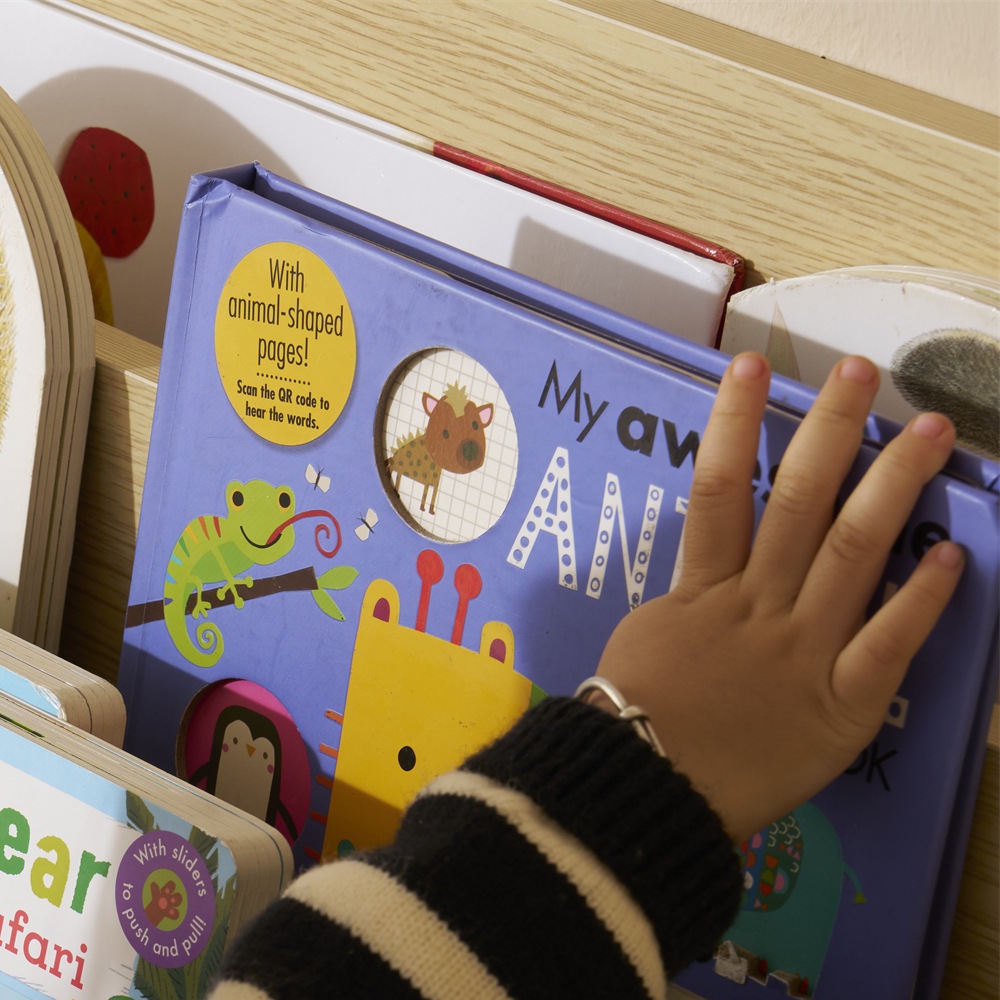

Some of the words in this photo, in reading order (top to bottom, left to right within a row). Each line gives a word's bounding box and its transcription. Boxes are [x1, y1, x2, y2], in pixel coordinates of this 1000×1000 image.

[269, 258, 305, 293] With
[228, 292, 344, 340] animal-shaped
[257, 337, 309, 370] pages!
[236, 379, 258, 397] Scan
[260, 383, 276, 400] the
[278, 387, 293, 404] QR
[296, 391, 317, 408] code
[320, 396, 330, 411] to
[537, 359, 610, 443] My
[245, 401, 266, 419] hear
[269, 406, 284, 423] the
[287, 412, 320, 430] words.
[133, 838, 167, 866] With
[171, 845, 207, 897] sliders
[122, 882, 134, 900] to
[121, 907, 150, 946] push
[181, 914, 207, 956] pull!
[152, 938, 179, 957] and
